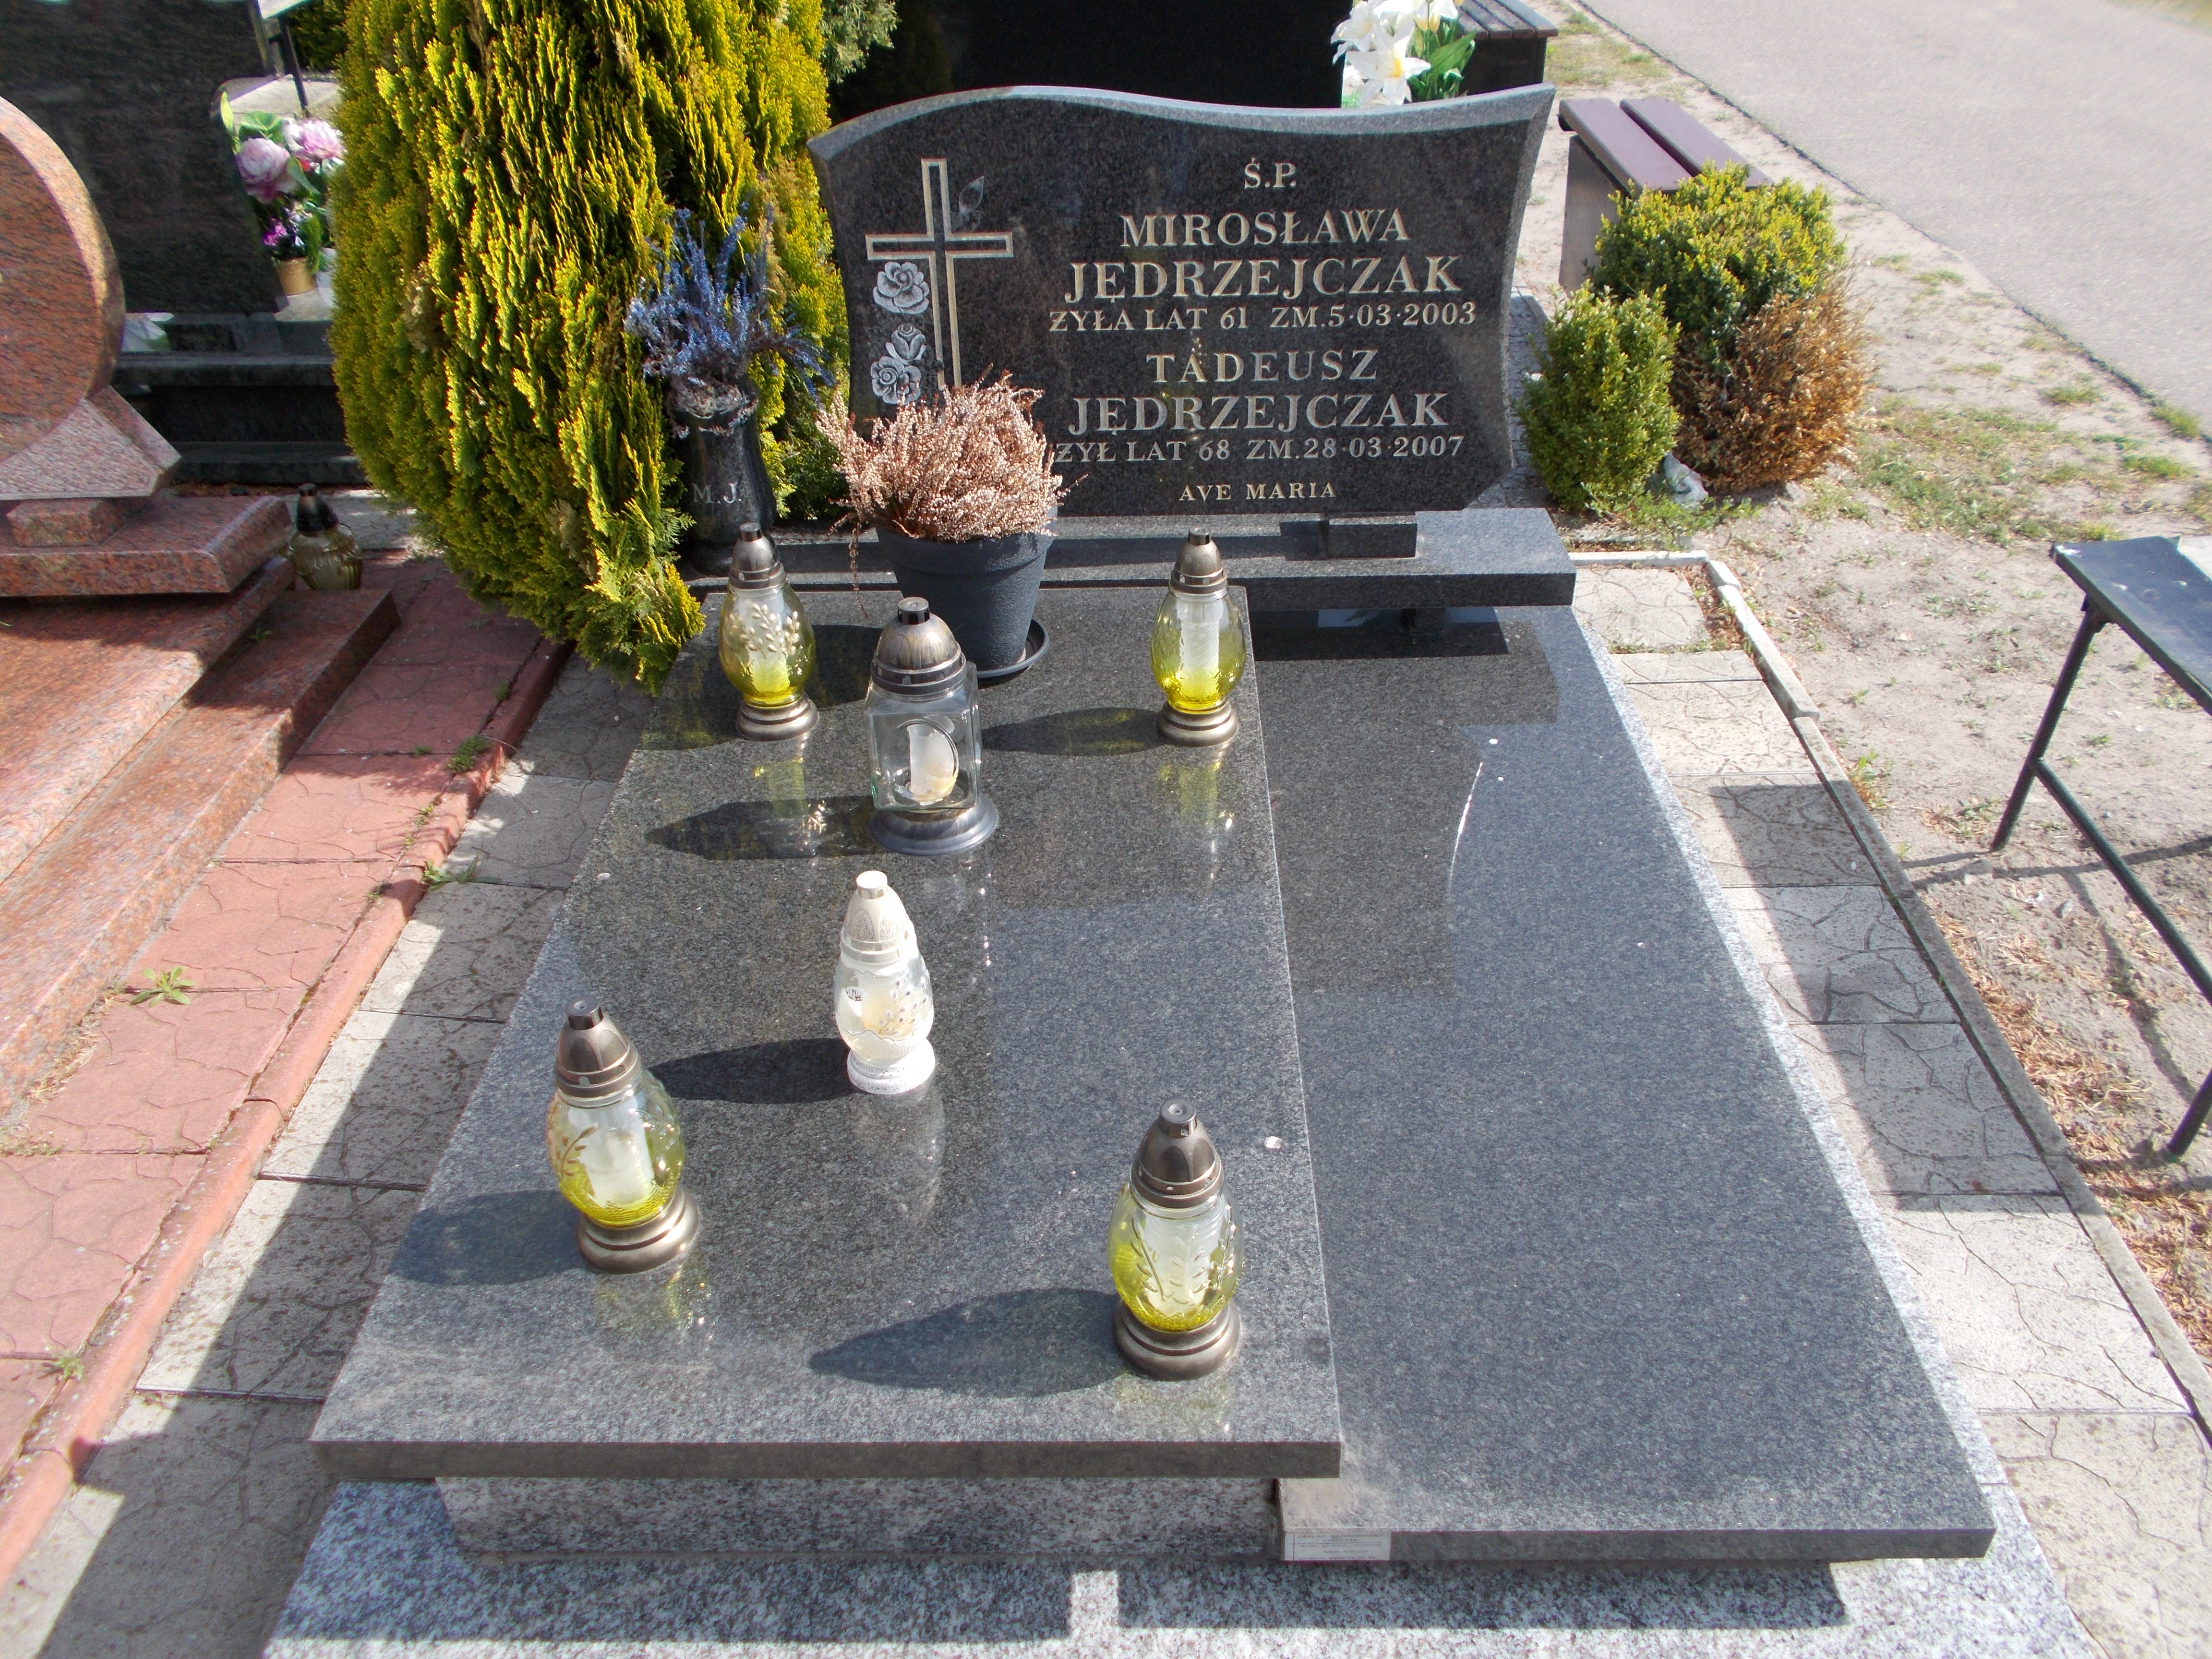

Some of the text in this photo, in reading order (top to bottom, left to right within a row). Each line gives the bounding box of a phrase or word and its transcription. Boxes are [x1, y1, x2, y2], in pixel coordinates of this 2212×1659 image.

[1244, 157, 1296, 189] Ś.P.
[1120, 208, 1410, 248] MIROSŁAWA
[1065, 255, 1463, 304] JĘDRZEJCZAK
[1144, 307, 1208, 330] LAT
[1220, 306, 1249, 329] 61
[1146, 349, 1379, 384] TADEUSZ
[1068, 392, 1449, 437] JĘDRZEJCZAK
[1126, 440, 1187, 461] LAT
[1199, 439, 1230, 461] 68
[1178, 481, 1337, 502] AVE MARIA
